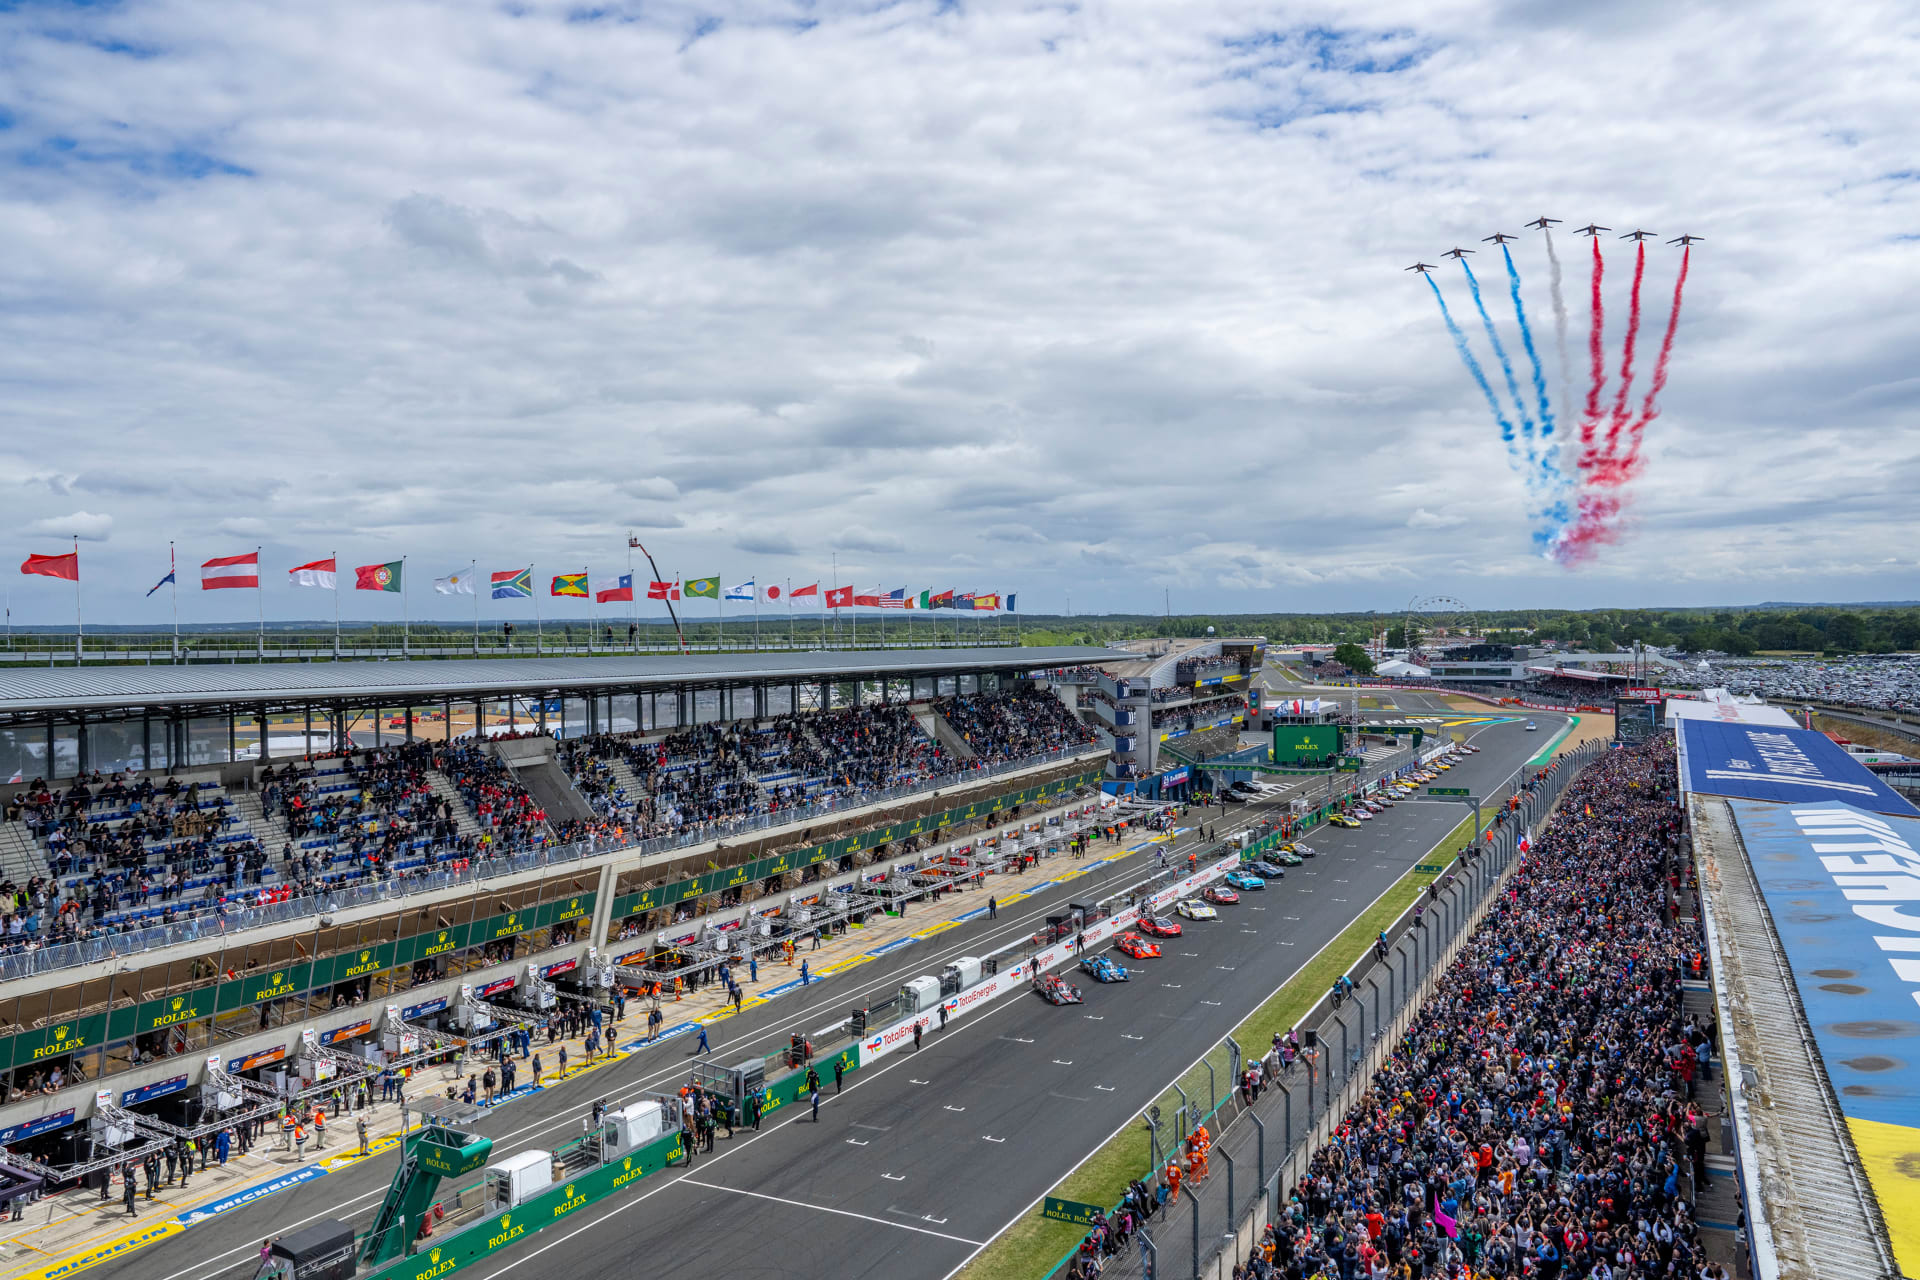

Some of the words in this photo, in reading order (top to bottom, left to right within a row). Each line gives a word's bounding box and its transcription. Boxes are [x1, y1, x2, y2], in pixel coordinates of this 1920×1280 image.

[811, 854, 827, 863] ROLEX
[772, 865, 789, 874] ROLEX
[729, 876, 748, 886] ROLEX
[683, 888, 704, 899] ROLEX
[560, 907, 585, 920] ROLEX
[632, 901, 655, 913] ROLEX
[496, 923, 524, 937] ROLEX
[425, 941, 456, 956] ROLEX
[346, 961, 380, 977] ROLEX
[256, 983, 294, 1000] ROLEX
[959, 982, 997, 1007] TotalEnergies
[153, 1007, 198, 1027] ROLEX
[33, 1037, 85, 1059] ROLEX
[231, 1061, 240, 1069] 92
[125, 1092, 136, 1101] 37
[426, 1157, 451, 1171] ROLEX
[613, 1167, 642, 1188] ROLEX
[214, 1170, 314, 1211] MICHELIN
[554, 1193, 587, 1217] ROLEX
[1047, 1210, 1072, 1221] ROLEX
[488, 1224, 525, 1249] ROLEX
[45, 1227, 168, 1279] MICHELIN
[416, 1257, 456, 1280] ROLEX
